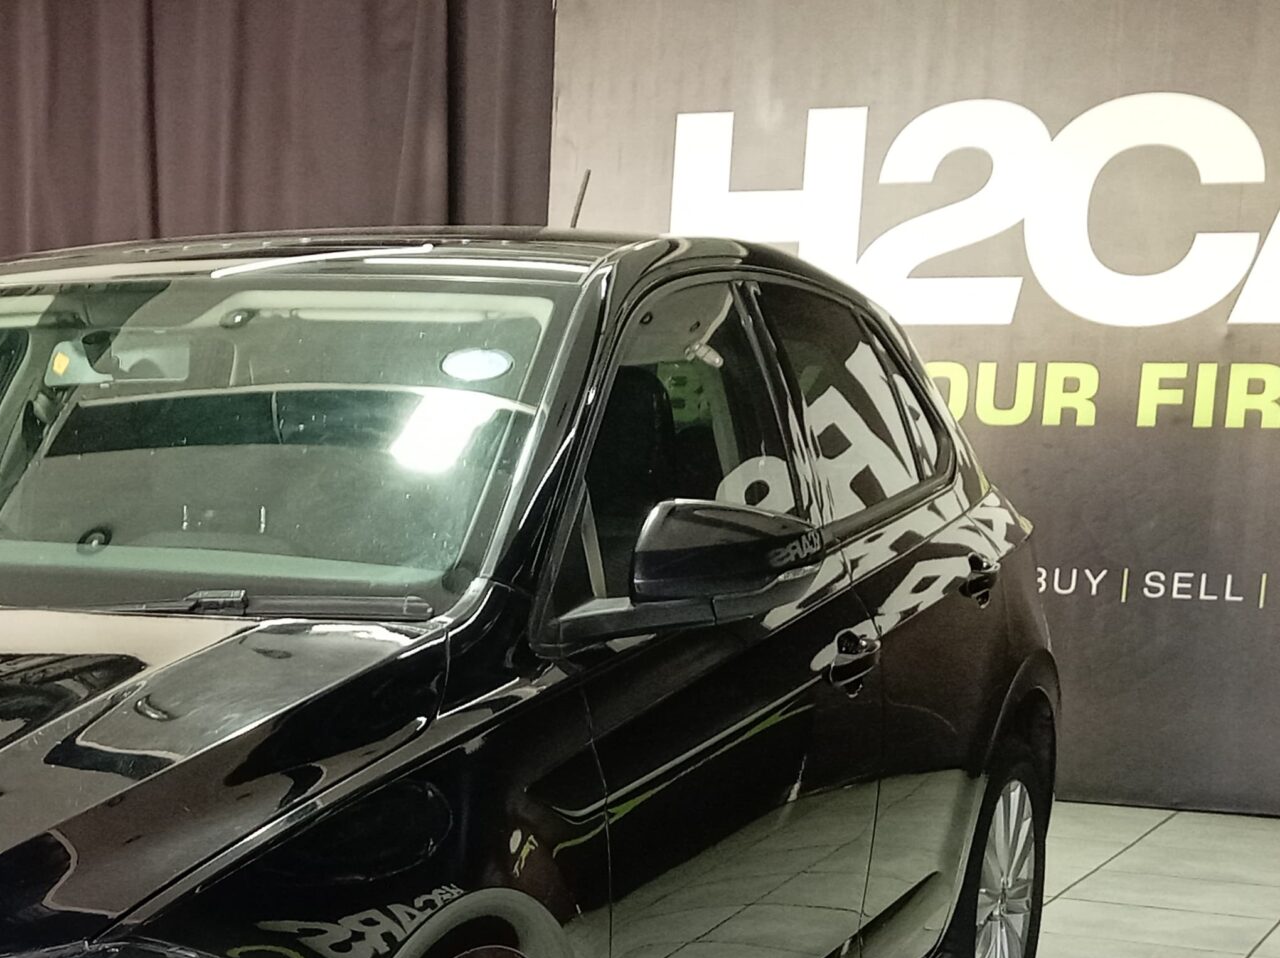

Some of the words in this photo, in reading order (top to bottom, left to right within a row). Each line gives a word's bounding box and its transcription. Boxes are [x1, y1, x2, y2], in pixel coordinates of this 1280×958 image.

[669, 91, 1280, 327] H2C
[1136, 362, 1280, 428] FIR
[1143, 570, 1244, 601] SELL
